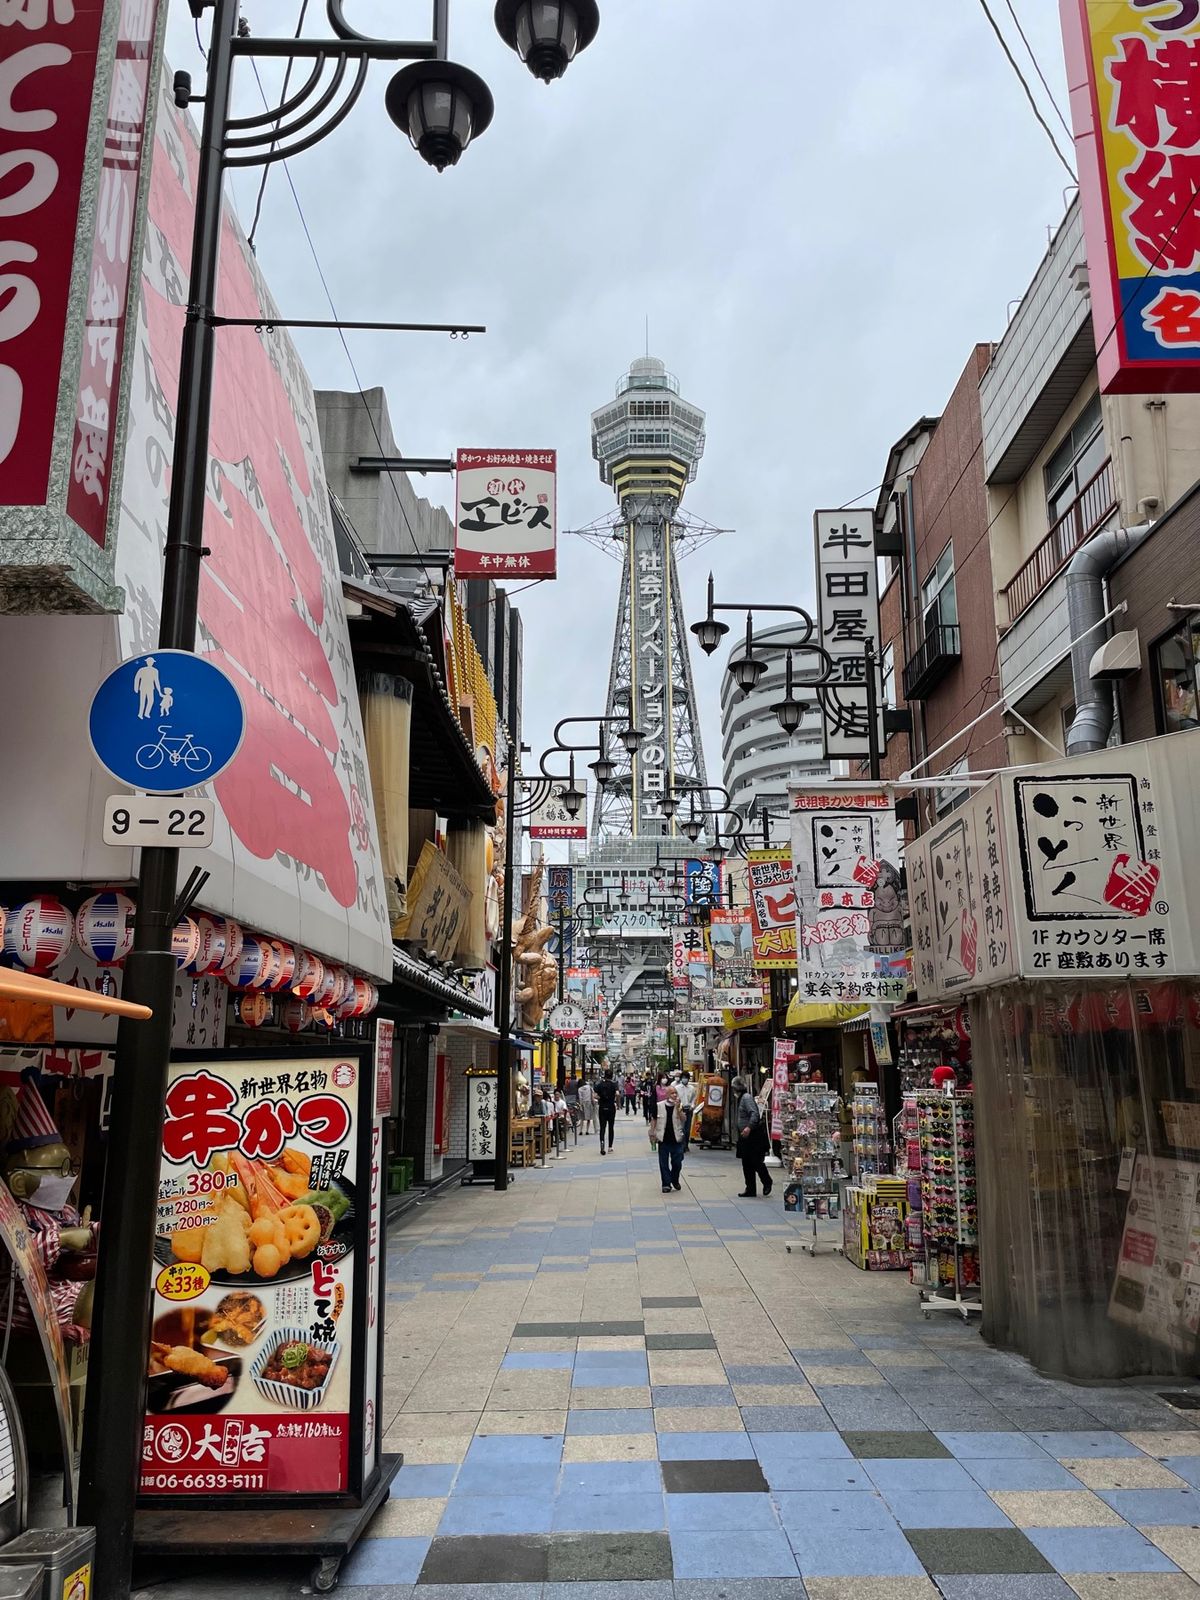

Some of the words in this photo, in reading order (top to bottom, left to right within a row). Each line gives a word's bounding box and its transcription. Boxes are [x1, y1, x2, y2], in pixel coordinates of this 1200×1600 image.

[460, 454, 553, 464] 串かつ・お好み焼き・焼きそば
[479, 555, 531, 568] 年中無休
[822, 523, 873, 738] 半田屋酒店
[638, 550, 666, 821] 社会イノベーションの日立
[794, 795, 889, 808] 元祖串カツ専門店
[1096, 793, 1128, 851] 新世界
[751, 862, 780, 876] 新世界
[754, 890, 769, 928] 大阪名物
[22, 909, 35, 952] アサヒビール
[42, 926, 64, 936] Asahi
[93, 920, 116, 928] Asahi
[1032, 929, 1050, 945] 1F
[1056, 928, 1166, 945] カウンター席
[1033, 952, 1051, 968] 2F
[1058, 951, 1169, 969] 座敷あります
[804, 982, 905, 997] 宴会予約受付中
[729, 996, 763, 1006] くら寿司
[240, 1070, 327, 1099] 新世界名物
[163, 1073, 350, 1167] 串かつ
[478, 1103, 493, 1156] 鶴亀家
[319, 1152, 335, 1188] 二度漬け
[333, 1150, 348, 1180] ソースの
[186, 1170, 238, 1195] 380円
[316, 1244, 347, 1257] おすすめ
[168, 1266, 196, 1277] 串かつ
[162, 1275, 204, 1294] 全33種
[310, 1261, 340, 1342] どて焼
[191, 1423, 272, 1463] 大吉
[156, 1474, 263, 1489] 06-6633-5111
